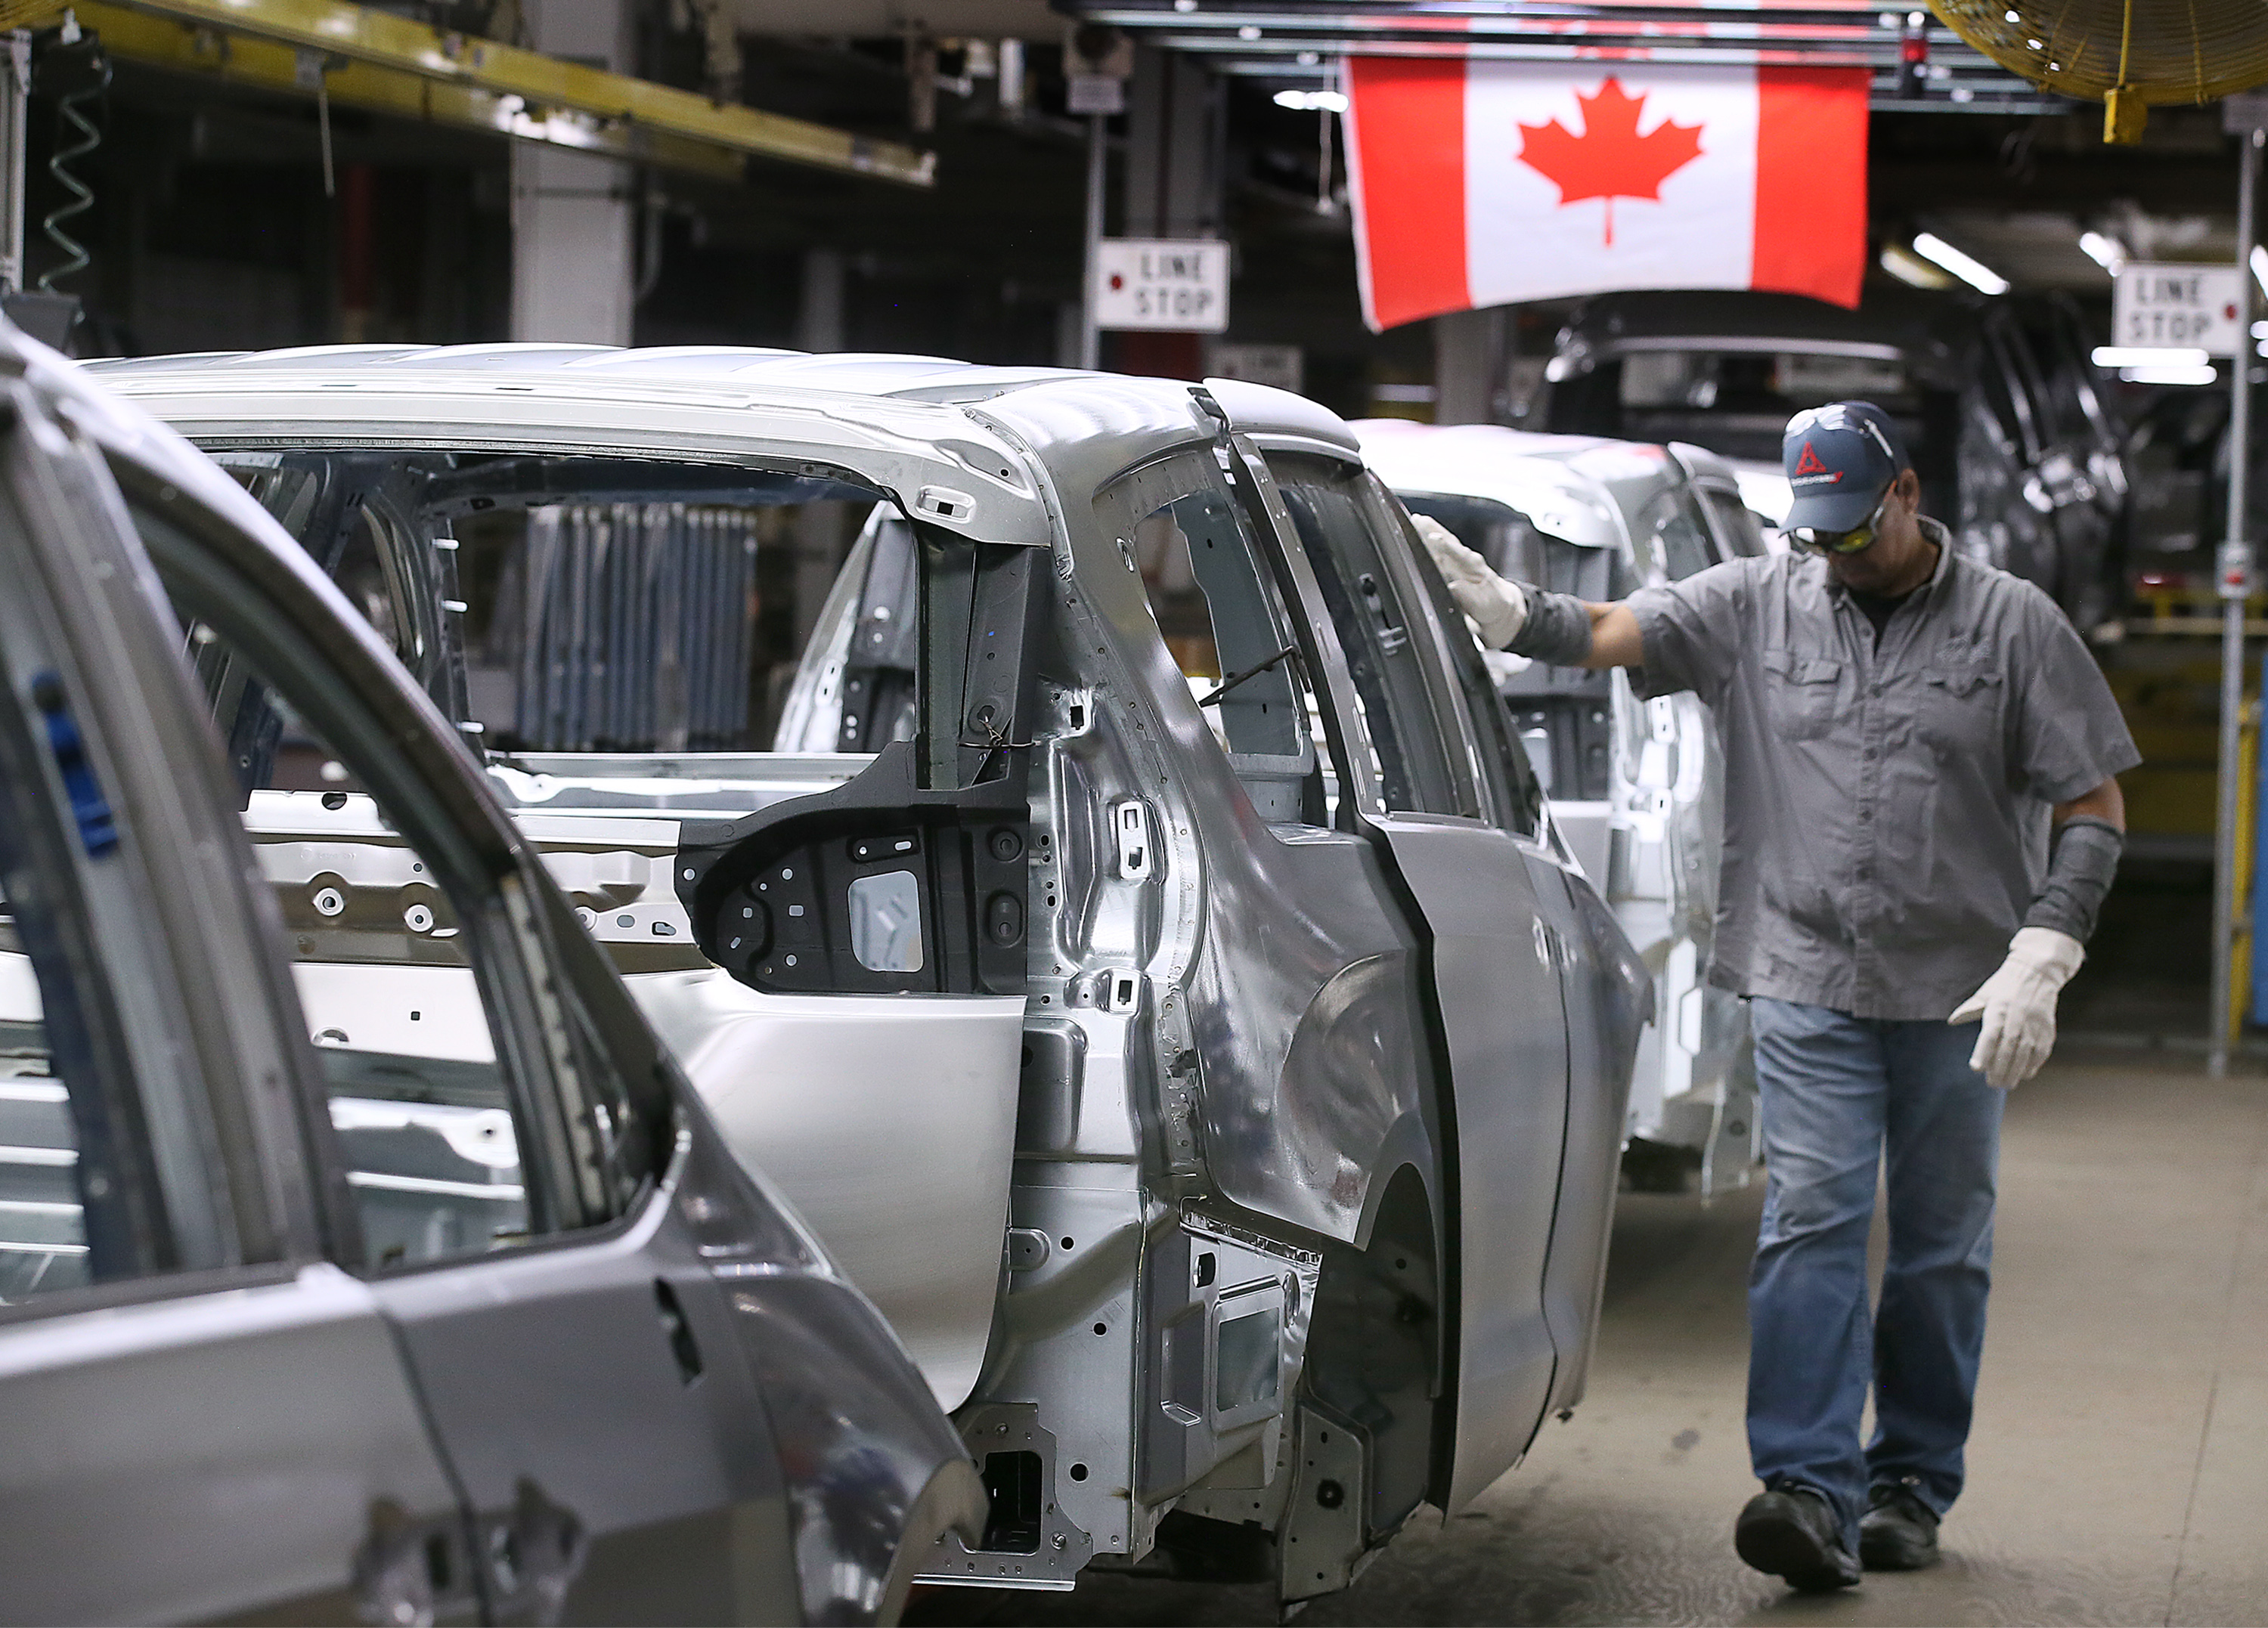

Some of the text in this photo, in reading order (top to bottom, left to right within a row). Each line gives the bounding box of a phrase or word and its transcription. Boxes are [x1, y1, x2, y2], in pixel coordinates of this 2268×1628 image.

[1140, 252, 1202, 281] LINE
[1136, 286, 1213, 316] STOP
[2136, 276, 2201, 305] LINE
[2130, 309, 2212, 341] STOP
